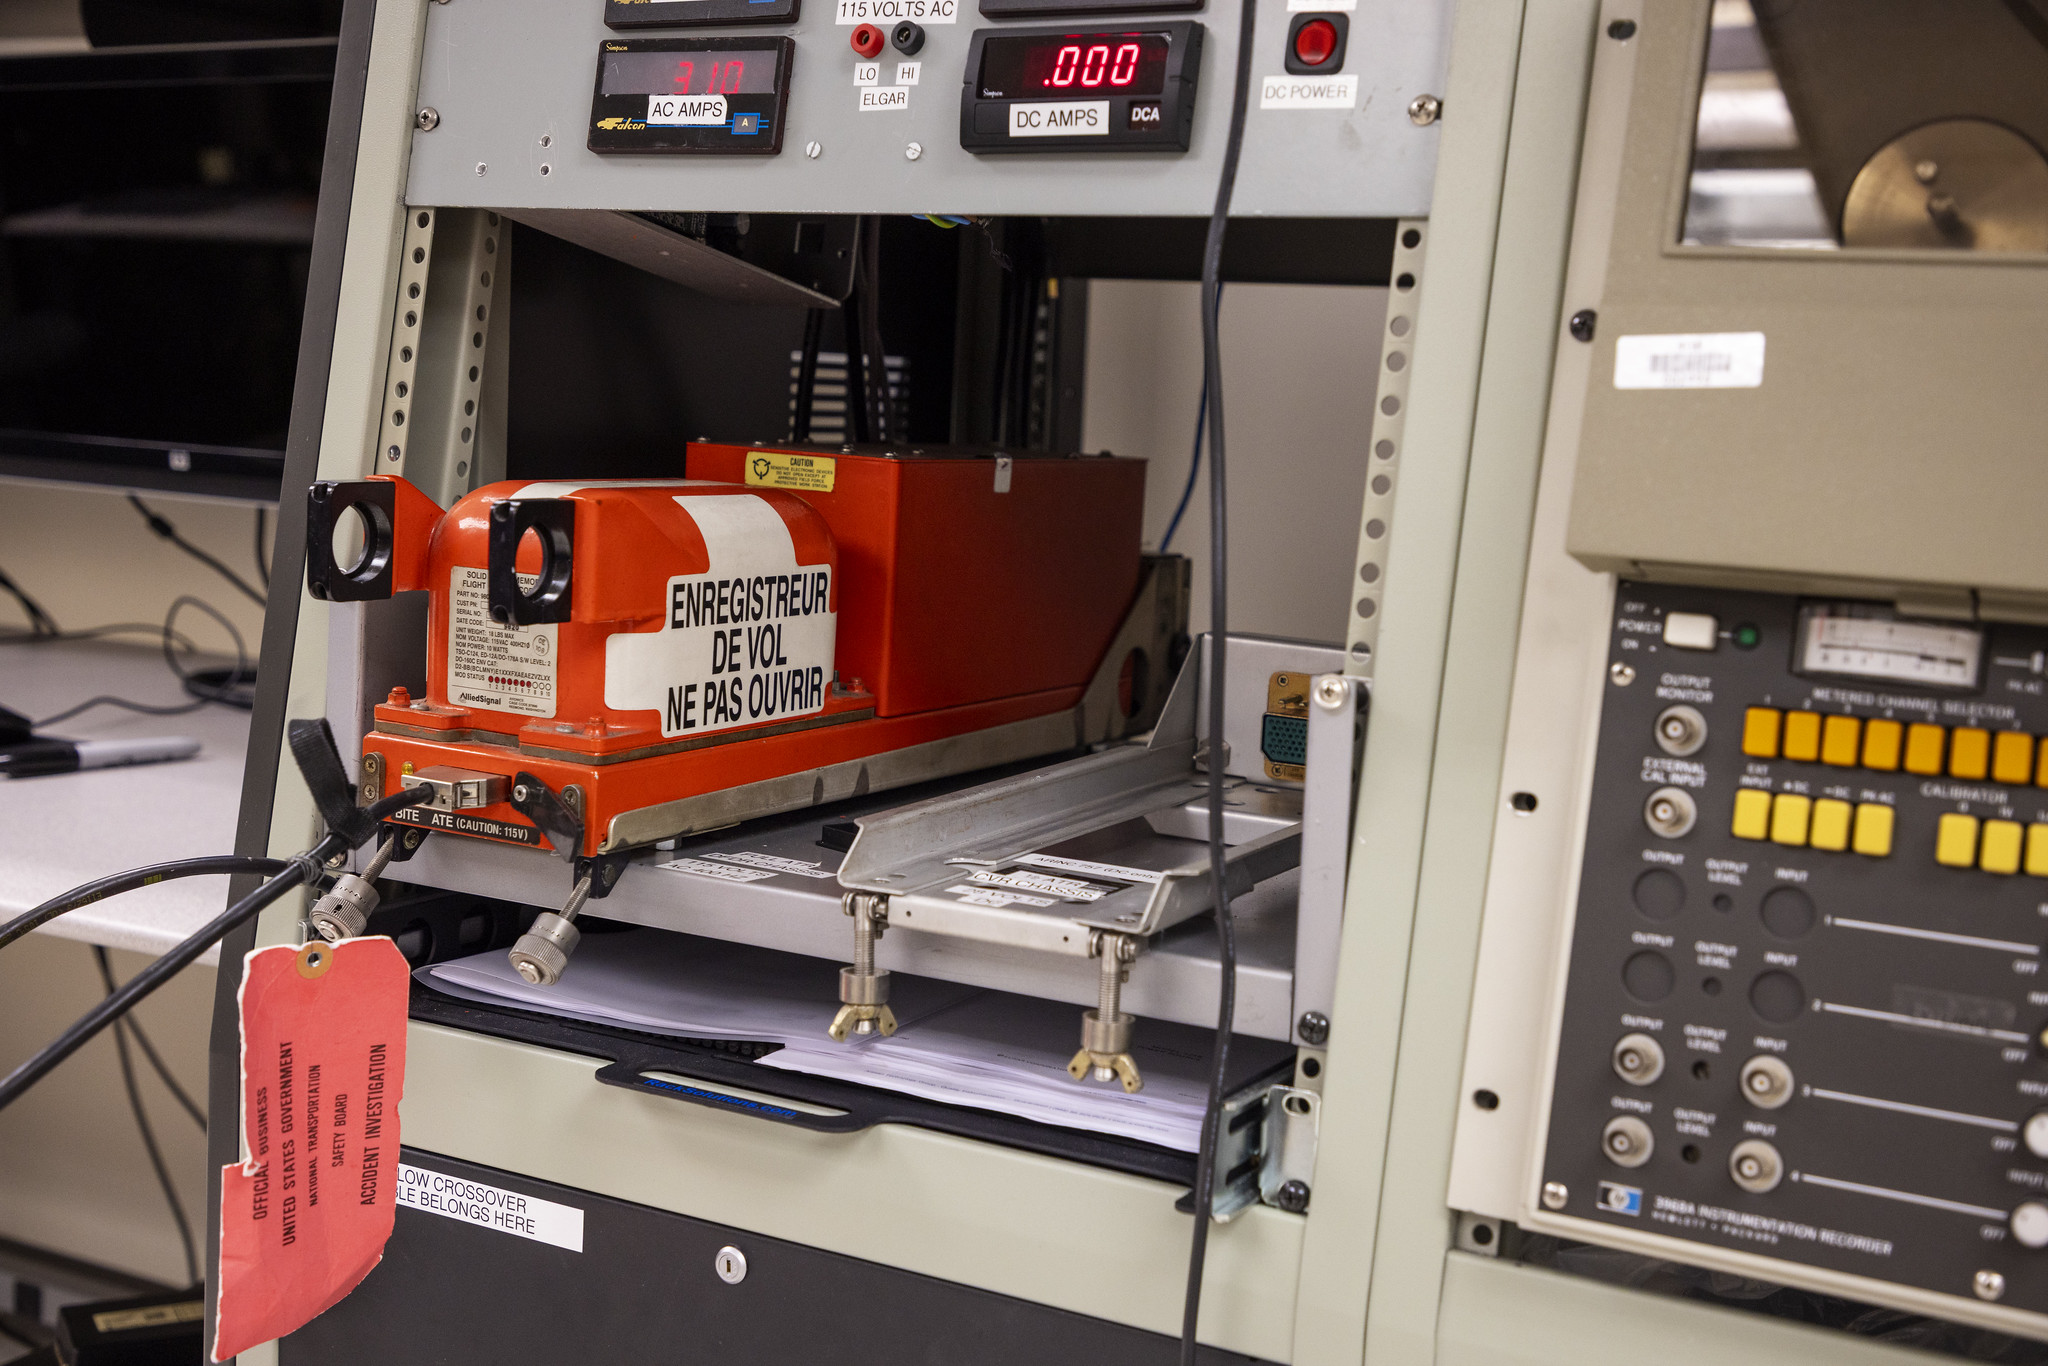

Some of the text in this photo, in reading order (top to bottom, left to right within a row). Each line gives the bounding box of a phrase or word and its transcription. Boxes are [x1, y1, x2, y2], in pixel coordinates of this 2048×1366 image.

[841, 0, 954, 18] 115 VOLTS AC
[605, 42, 629, 53] Simpson
[860, 67, 876, 81] LO
[901, 67, 916, 80] HI
[862, 92, 907, 106] ELGAR
[1265, 84, 1348, 99] DC POWER
[652, 101, 723, 118] AC AMPS
[1131, 107, 1160, 121] DCA
[741, 118, 749, 127] A
[1016, 108, 1098, 128] DC AMPS
[790, 458, 813, 467] CAUTION
[466, 571, 487, 580] SOLID
[462, 580, 486, 590] FLIGHT
[456, 590, 469, 598] PART
[470, 591, 480, 599] NO:
[671, 571, 828, 630] ENREGISTREUR
[456, 608, 473, 616] SERIAL
[1624, 602, 1647, 613] OFF
[469, 618, 485, 626] CODE:
[1617, 619, 1663, 634] POWER
[467, 628, 487, 636] WEIGHT:
[504, 632, 515, 640] MAX
[467, 635, 490, 643] VOLTAGE:
[491, 638, 509, 646] 115VAC
[493, 646, 509, 654] WATTS
[712, 623, 787, 675] DE VOL
[1621, 638, 1639, 650] ON
[530, 658, 547, 666] LEVEL:
[455, 671, 467, 679] MOD
[466, 672, 485, 681] STATUS
[1660, 672, 1713, 689] OUTPUT
[459, 692, 502, 706] AlliedSignal
[667, 665, 823, 732] NE PAS OUVRIR
[1655, 686, 1714, 704] MONITOR
[1812, 686, 1875, 707] METERED
[1878, 693, 1938, 714] CHANNEL
[1943, 698, 2015, 721] SELECTOR
[1642, 756, 1707, 775] EXTERNAL
[1640, 770, 1707, 788] CAL INPUT
[1739, 775, 1773, 789] INPUT
[1919, 781, 2009, 804] CALIBRATOR
[395, 807, 528, 841] BITE ATE (CAUTION: 115V)
[1642, 848, 1685, 866] OUTPUT
[1705, 858, 1748, 874] OUTPUT
[1707, 871, 1742, 886] LEVEL
[1775, 867, 1809, 882] INPUT
[973, 872, 1013, 885] CVR
[1010, 879, 1095, 899] CHASSIS
[1631, 930, 1674, 948] OUTPUT
[1695, 940, 1738, 957] OUTPUT
[1697, 954, 1732, 970] LEVEL
[1764, 951, 1798, 967] INPUT
[1621, 1013, 1664, 1031] OUTPUT
[1684, 1023, 1727, 1041] OUTPUT
[1686, 1037, 1721, 1053] LEVEL
[1754, 1036, 1788, 1052] INPUT
[643, 1078, 798, 1118] RackSolutions.com
[1610, 1095, 1653, 1114] OUTPUT
[1673, 1107, 1716, 1125] OUTPUT
[332, 1093, 348, 1167] SAFETY BOARD
[360, 1043, 387, 1206] ACCIDENT INVESTIGATION
[1676, 1122, 1711, 1138] LEVEL
[1743, 1120, 1777, 1137] INPUT
[279, 1040, 297, 1247] UNITED STATES GOVERNMENT
[307, 1064, 321, 1207] NATIONAL TRANSPORTATION
[252, 1086, 270, 1221] OFFICIAL BUSINESS
[433, 1176, 527, 1215] CROSSOVER
[420, 1191, 490, 1223] BELONGS
[494, 1214, 536, 1235] HERE
[1697, 1204, 1818, 1241] INSTRUMENTATION
[1820, 1229, 1894, 1256] RECORDER
